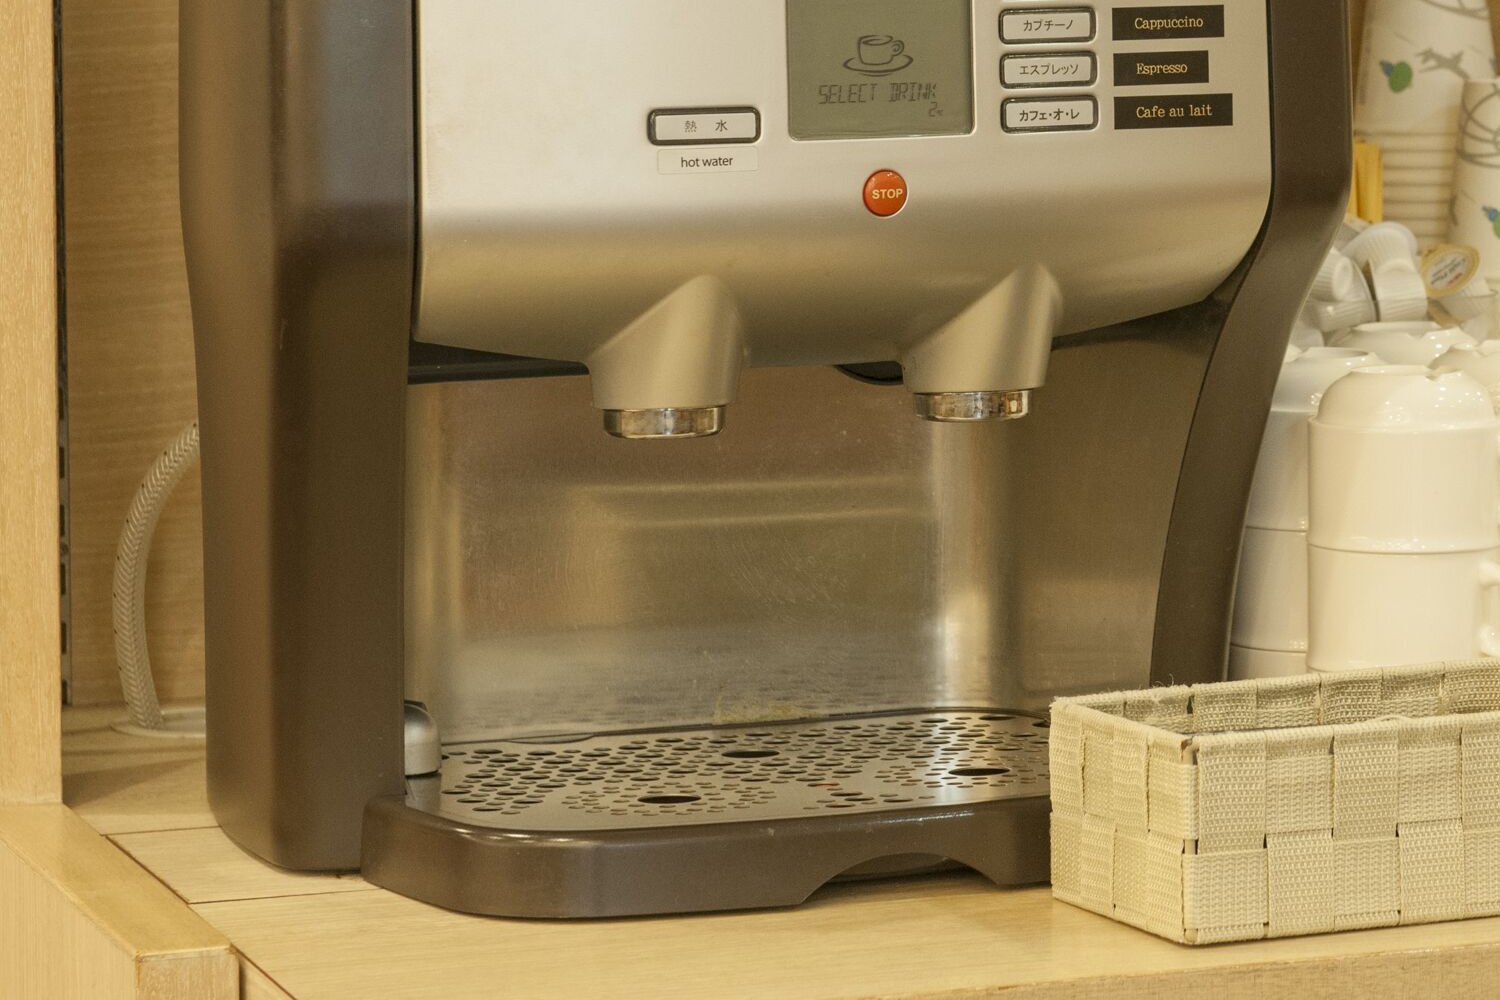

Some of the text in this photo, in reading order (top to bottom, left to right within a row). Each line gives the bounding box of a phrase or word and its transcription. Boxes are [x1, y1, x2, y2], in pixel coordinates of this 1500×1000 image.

[1023, 19, 1074, 32] カプチーノ
[1134, 15, 1204, 31] Cappuccino
[1019, 63, 1079, 75] エスプレッソ
[1136, 62, 1188, 76] Espresso
[818, 81, 937, 104] SELECT DRINK
[1019, 108, 1080, 122] カフェ・オ・レ
[1136, 104, 1213, 119] Cafe au lait
[680, 156, 734, 168] hot water
[871, 187, 903, 200] STOP
